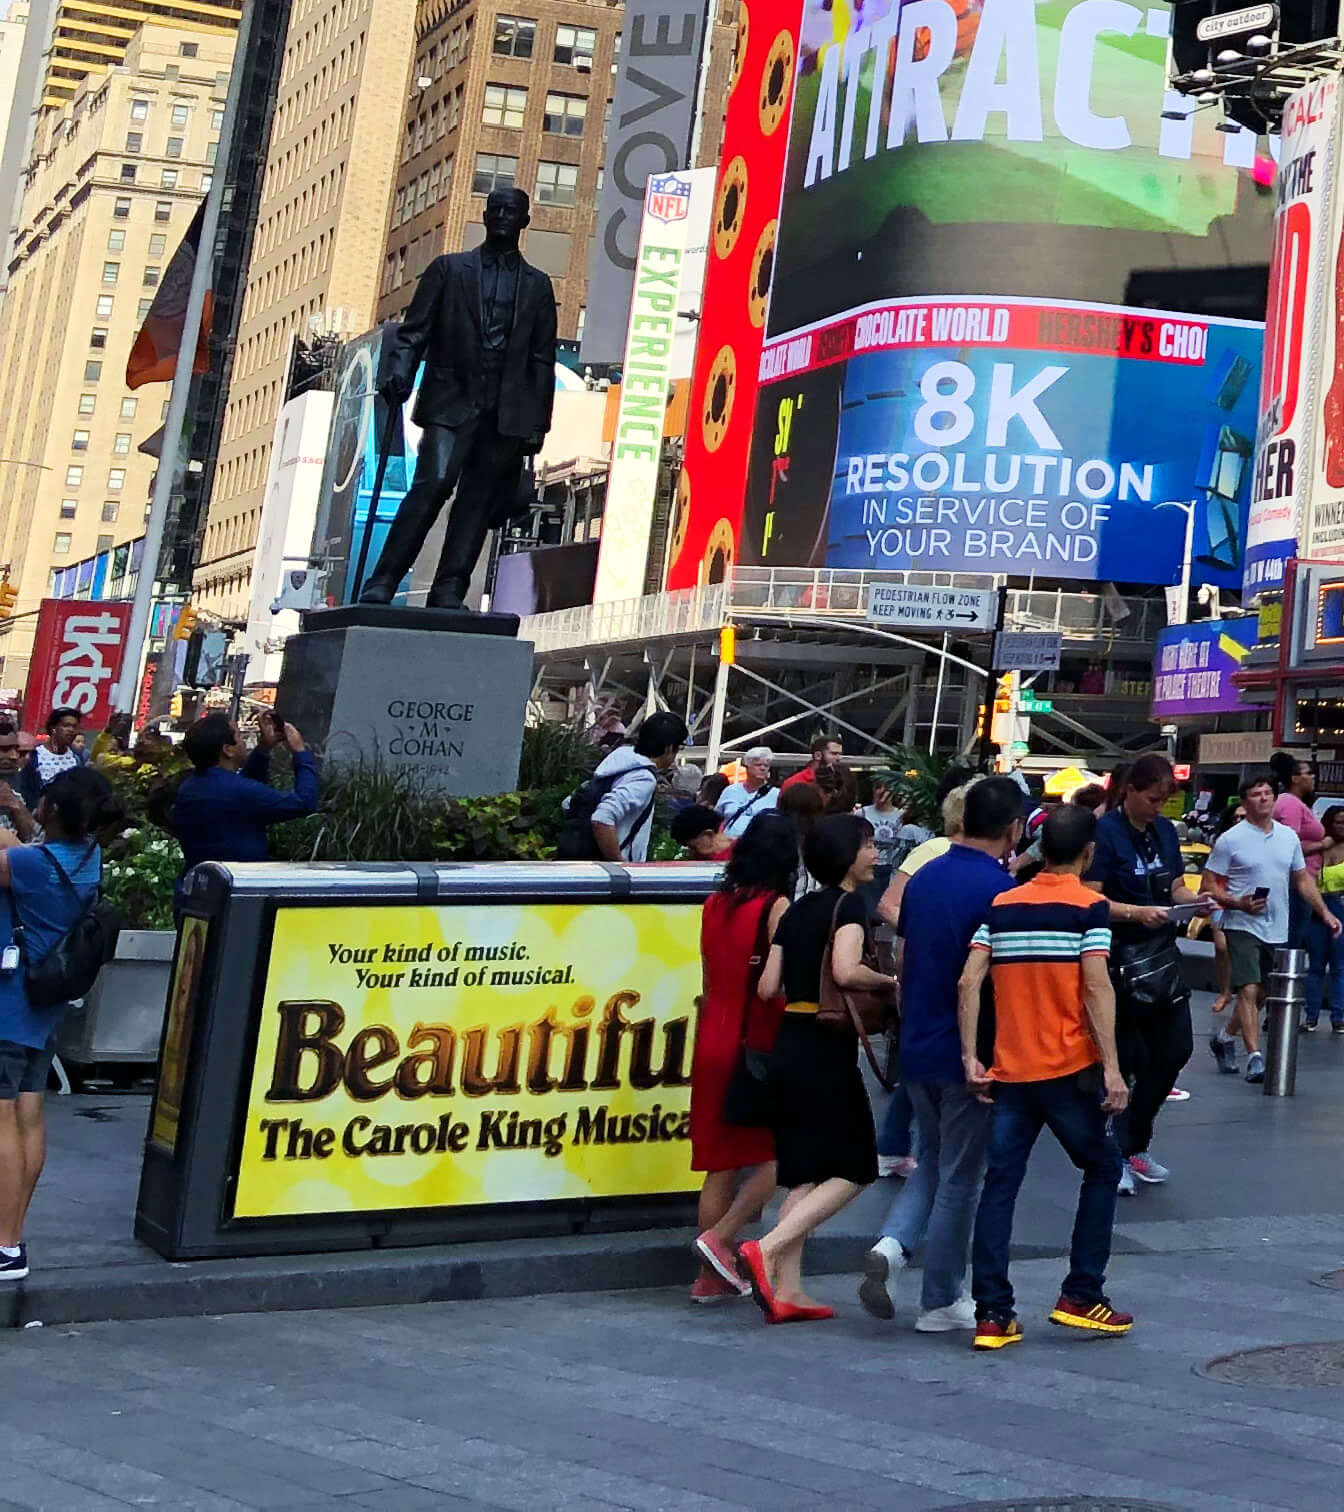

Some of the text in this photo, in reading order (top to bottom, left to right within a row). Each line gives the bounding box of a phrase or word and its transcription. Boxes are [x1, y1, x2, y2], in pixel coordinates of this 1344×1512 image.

[1204, 8, 1267, 34] city outdoor
[650, 194, 685, 218] NFL
[854, 308, 928, 350] CHOCOLATE
[932, 308, 1009, 343] WORLD
[1158, 323, 1208, 360] CHO
[617, 244, 682, 463] EXPERIENCE
[914, 360, 1071, 451] 8K
[846, 452, 1154, 501] RESOLUTION
[862, 497, 1112, 532] IN SERVICE OF
[866, 528, 1098, 563] YOUR BRAND
[874, 589, 981, 606] PEDESTRIAN FLOW ZONE
[872, 605, 932, 619] KEEP MOVING
[52, 611, 121, 715] tkts
[388, 700, 474, 721] GEORGE
[420, 721, 438, 738] M
[389, 738, 464, 757] COHAN
[327, 942, 531, 966] Your kind of music.
[354, 965, 576, 990] Your kind of musical.
[259, 1103, 692, 1162] The Carole King Musica
